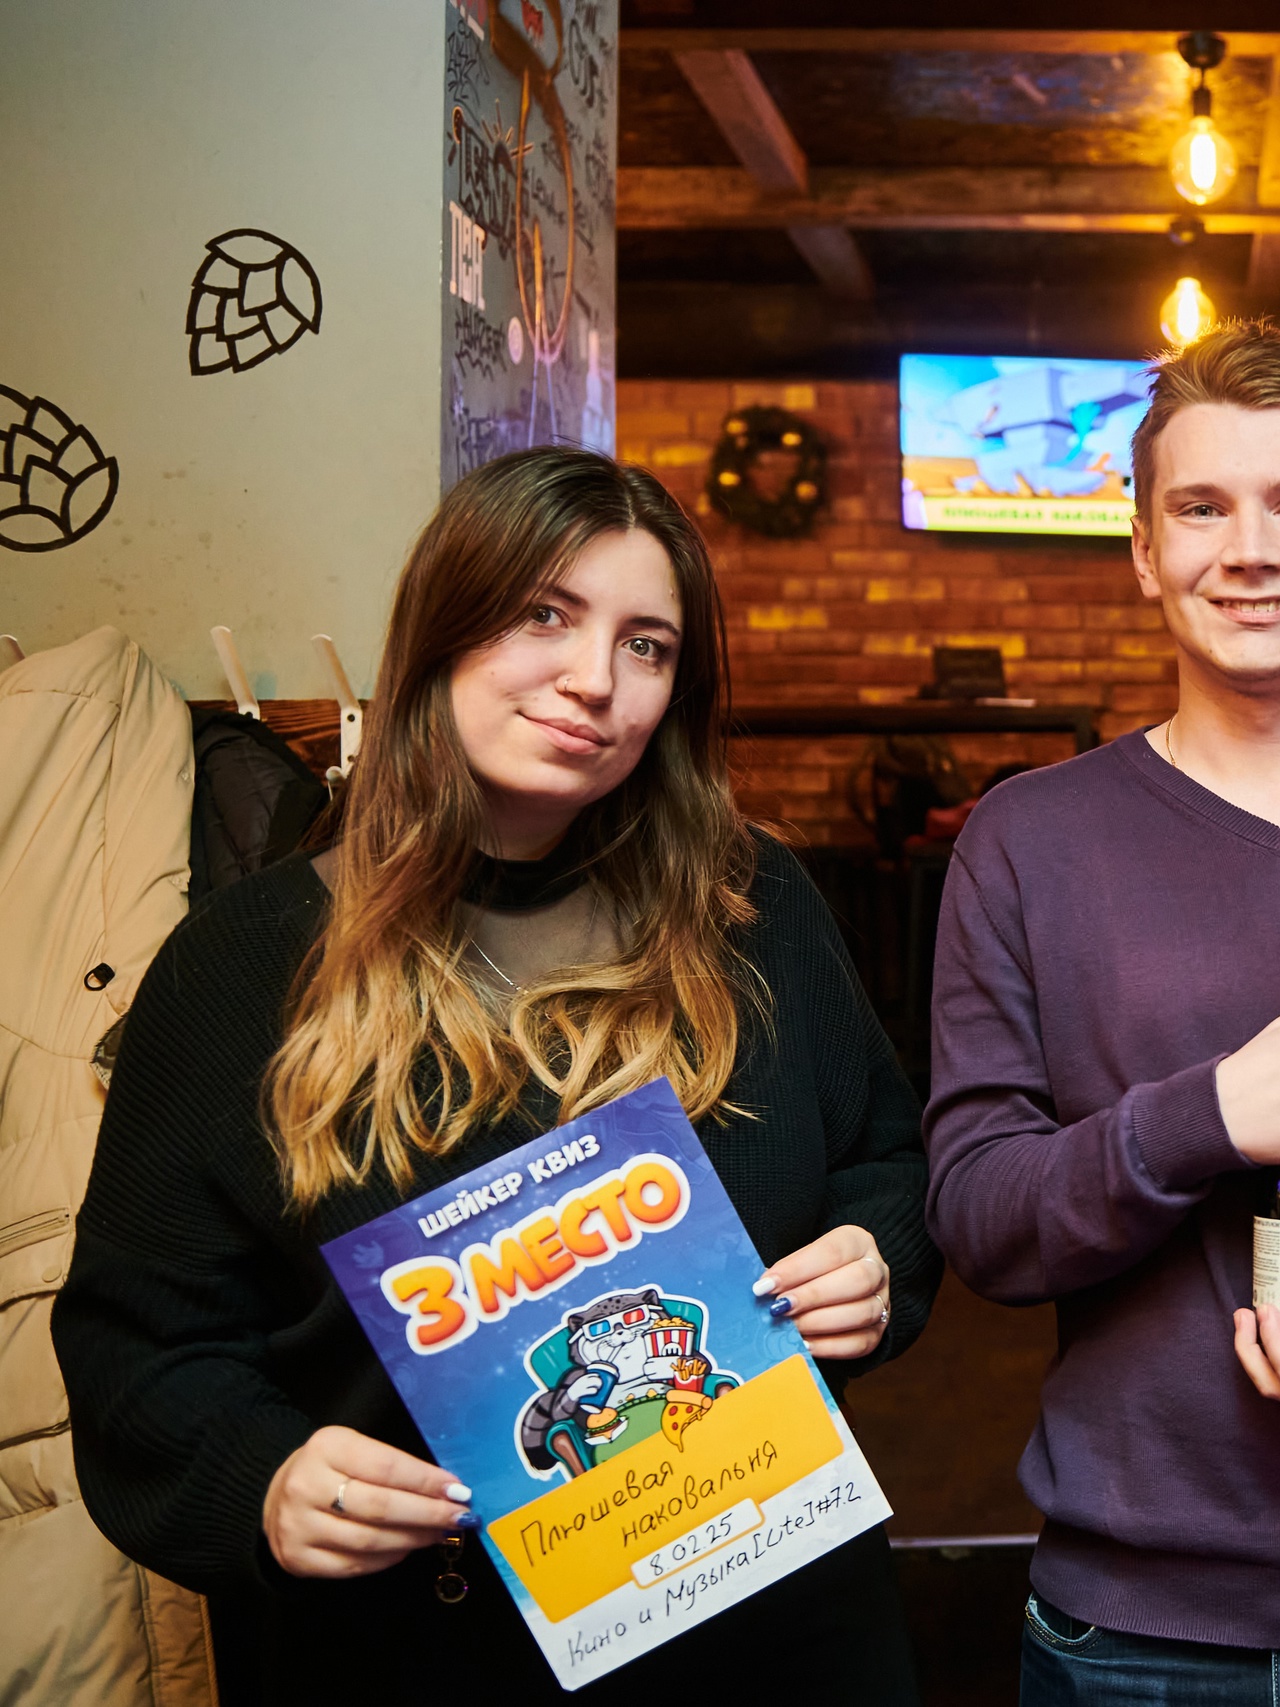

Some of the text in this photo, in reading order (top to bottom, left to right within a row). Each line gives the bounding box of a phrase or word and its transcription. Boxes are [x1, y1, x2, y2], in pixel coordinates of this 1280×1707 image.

[417, 1134, 601, 1239] ШЕЙКЕР КВИЗ
[391, 1162, 681, 1346] 3 МЕСТО
[520, 1460, 675, 1567] Плюшевая
[621, 1440, 779, 1548] наковальня
[567, 1624, 627, 1667] Кино
[639, 1609, 653, 1624] и
